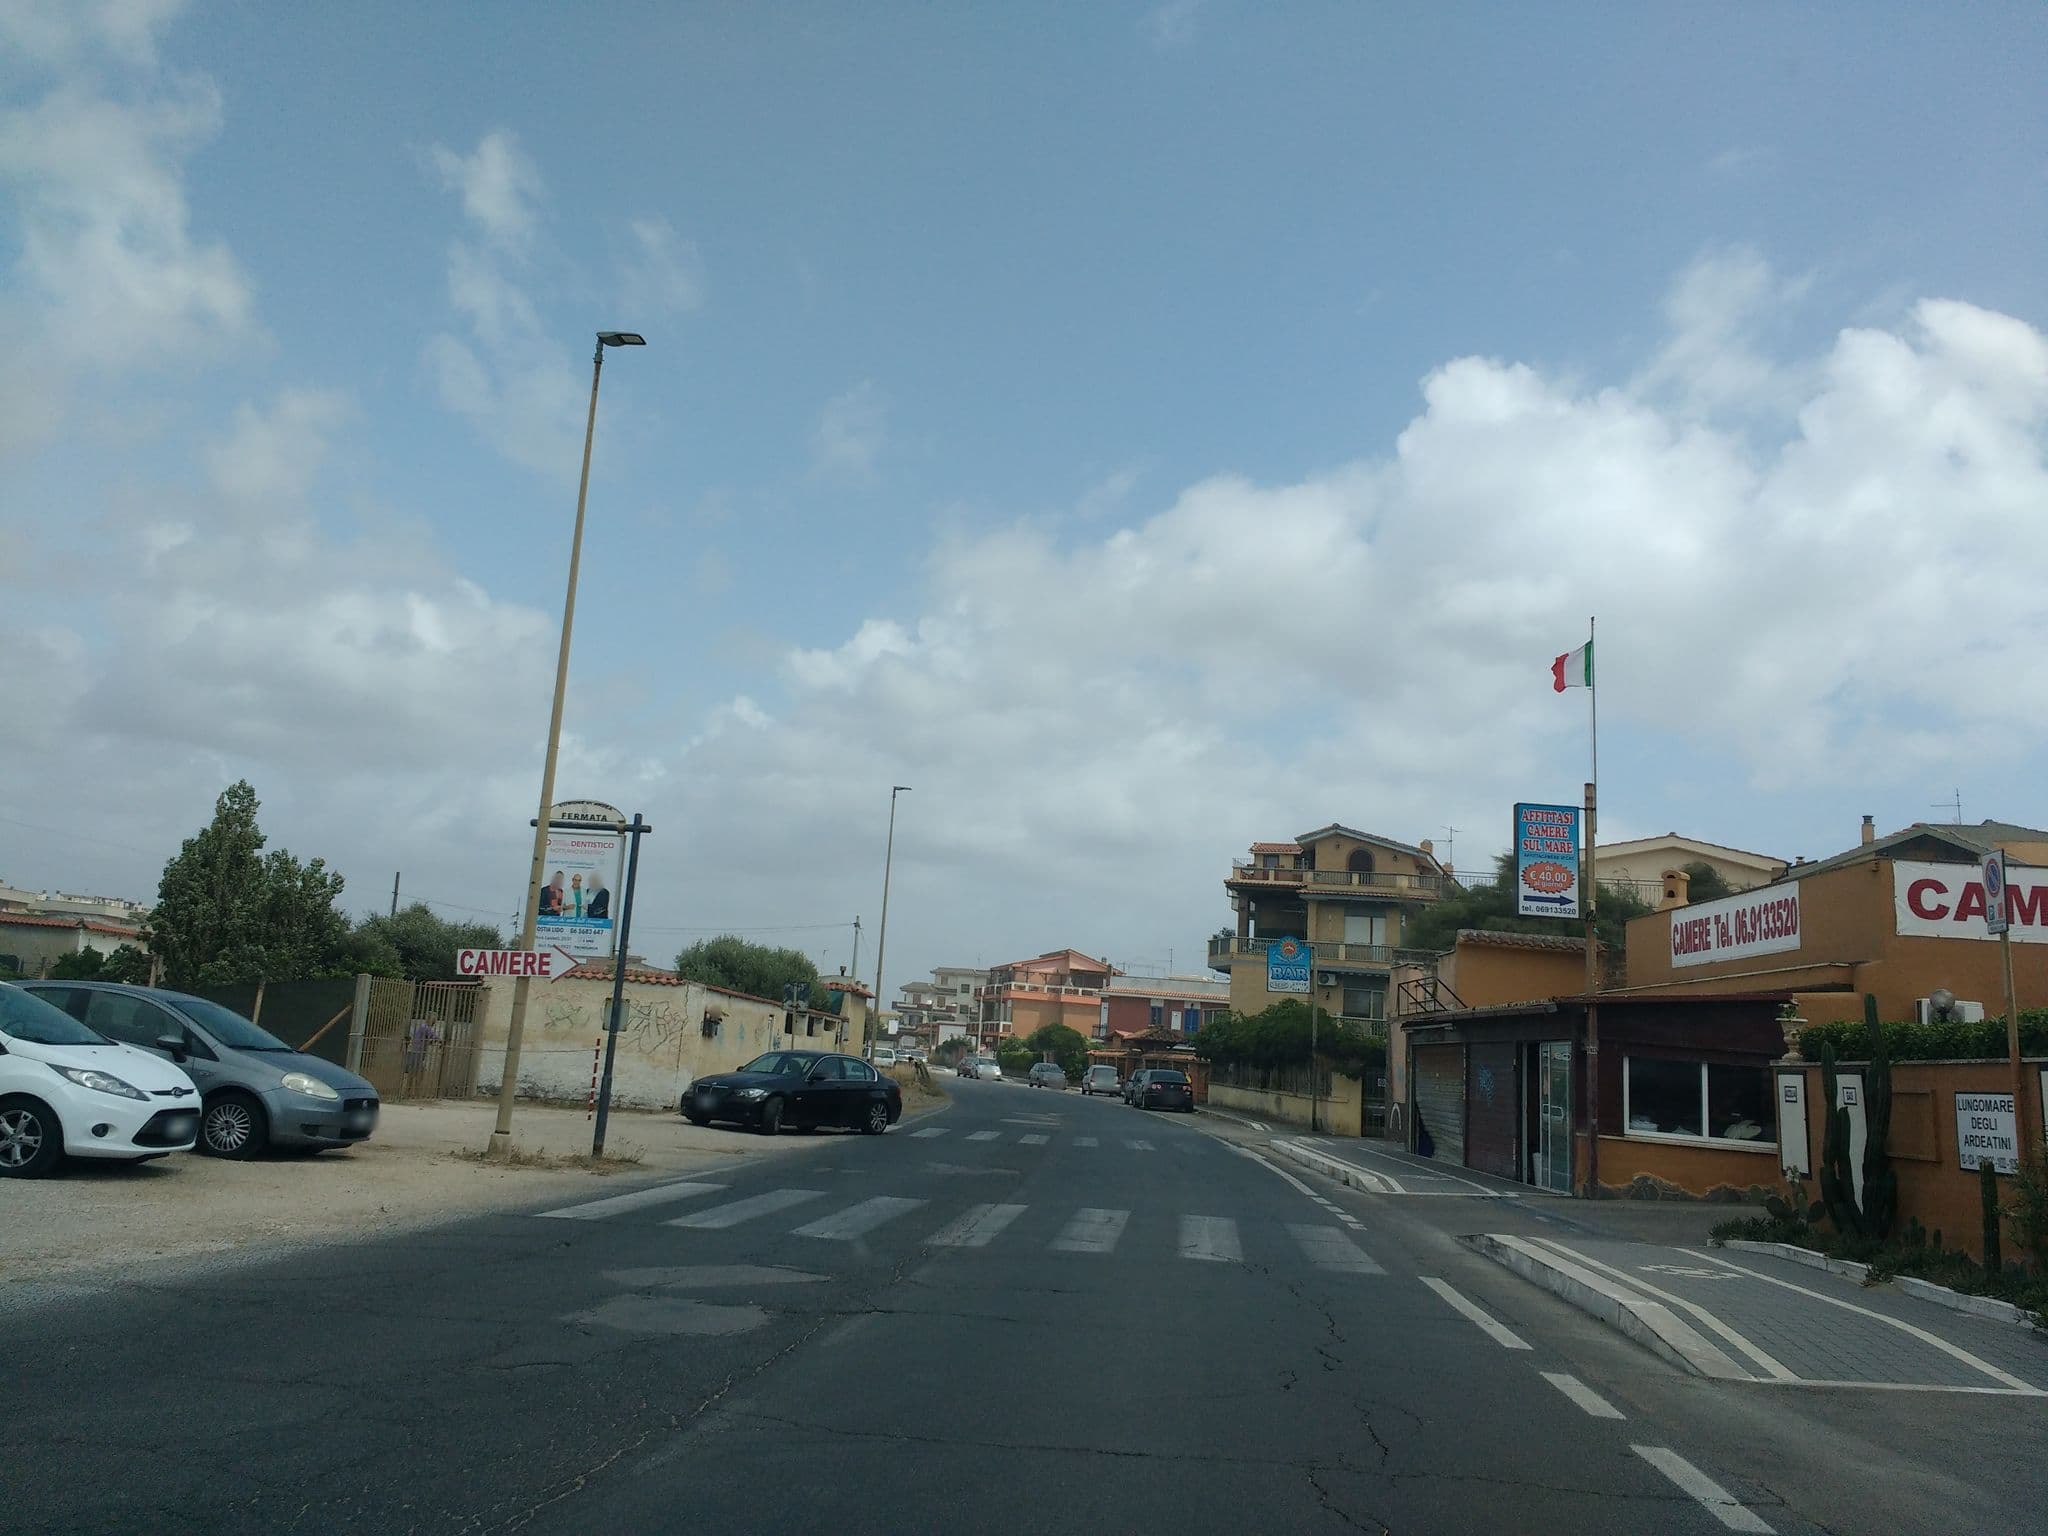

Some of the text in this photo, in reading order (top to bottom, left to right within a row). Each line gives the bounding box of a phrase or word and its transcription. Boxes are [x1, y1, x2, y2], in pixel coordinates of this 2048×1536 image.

[561, 812, 608, 822] FERMATA
[1521, 810, 1573, 825] AFFITTASI
[1527, 825, 1568, 839] CAMERE
[570, 840, 615, 849] DENTISTICO
[1523, 839, 1573, 853] SUL MARE
[1530, 870, 1567, 882] € 40,00
[1536, 905, 1577, 915] 069133520
[1673, 896, 1798, 956] CAMERE Tel. 06.9133520
[460, 950, 551, 976] CAMERE
[1270, 966, 1309, 981] BAR
[1957, 1098, 2014, 1113] LUNGOMARE
[1971, 1117, 1997, 1131] DEGLI
[1964, 1135, 2011, 1150] ARDEATINI
